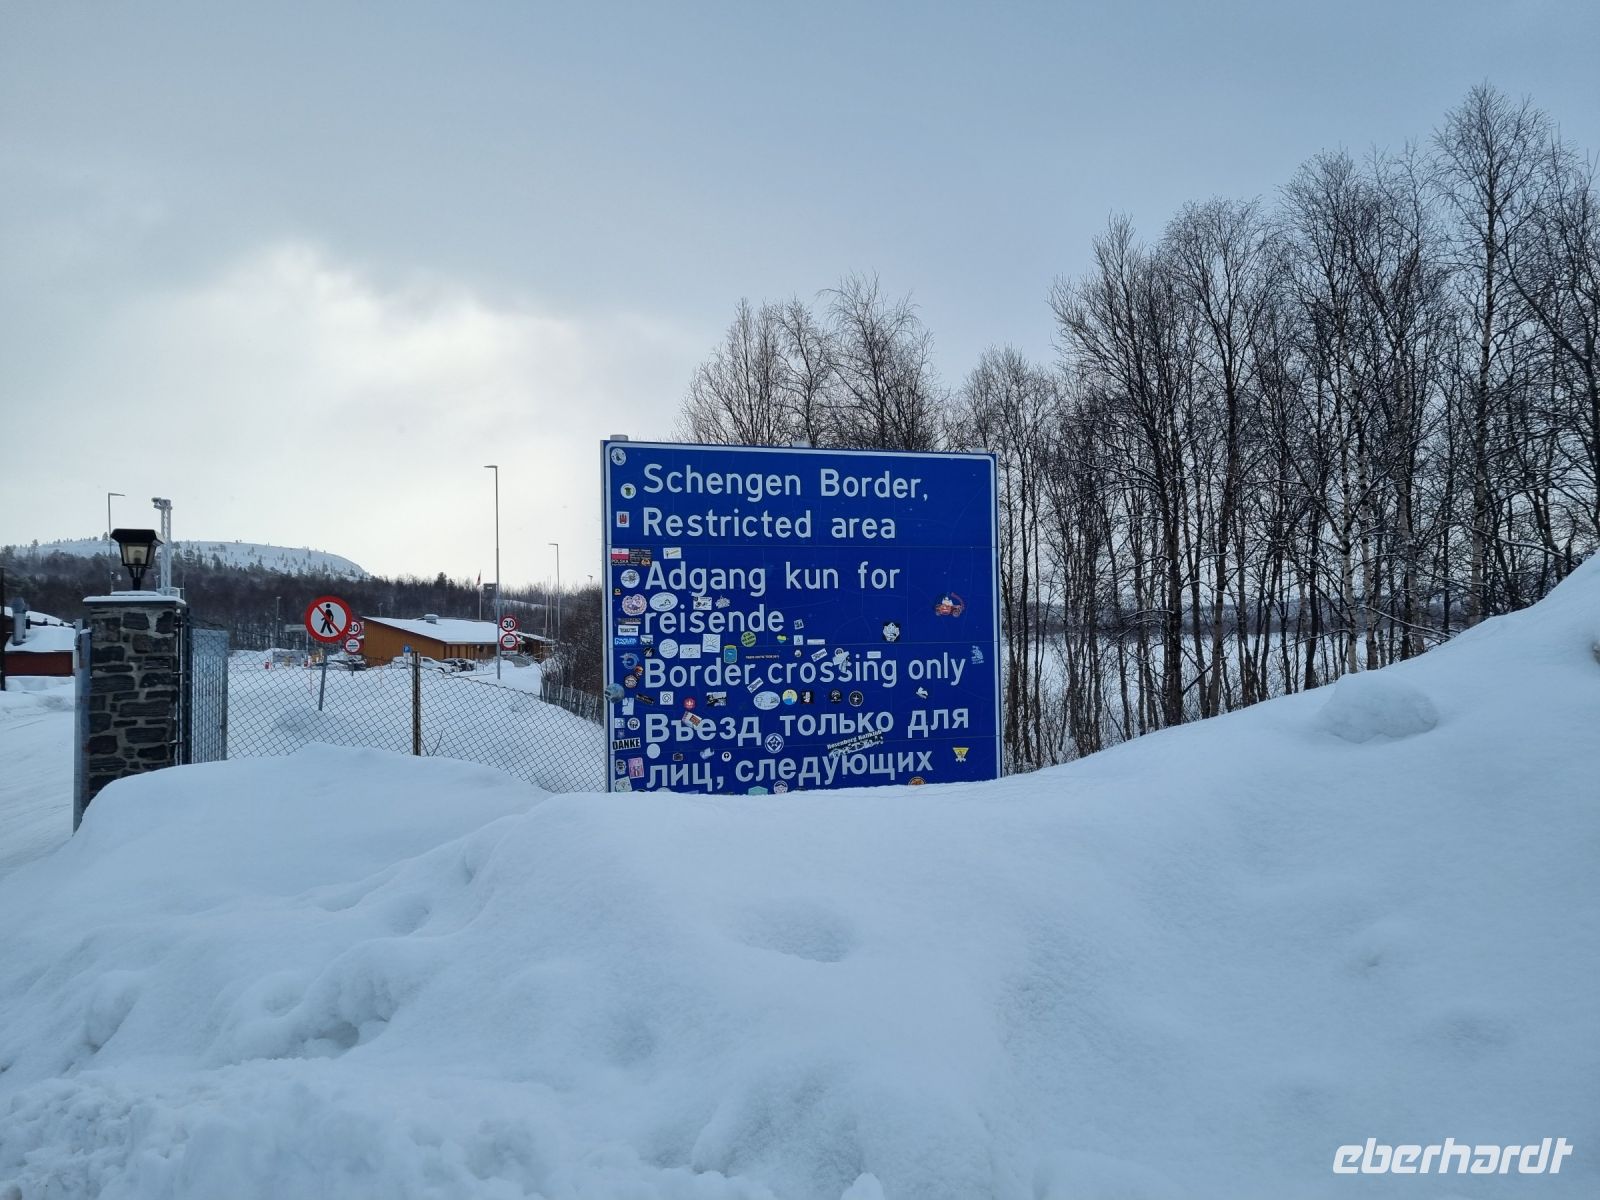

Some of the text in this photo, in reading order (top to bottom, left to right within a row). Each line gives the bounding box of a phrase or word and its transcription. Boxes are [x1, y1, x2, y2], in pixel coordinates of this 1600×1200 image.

[643, 463, 929, 502] Schengen Border,
[643, 507, 896, 539] Restricted area
[645, 561, 900, 597] Adgang kun for
[503, 620, 515, 628] 30
[645, 604, 785, 634] reisende
[645, 652, 966, 689] Border crossing only
[612, 738, 640, 751] DANKE
[645, 708, 969, 747] Въезд только для
[646, 751, 934, 792] лиц, следующих
